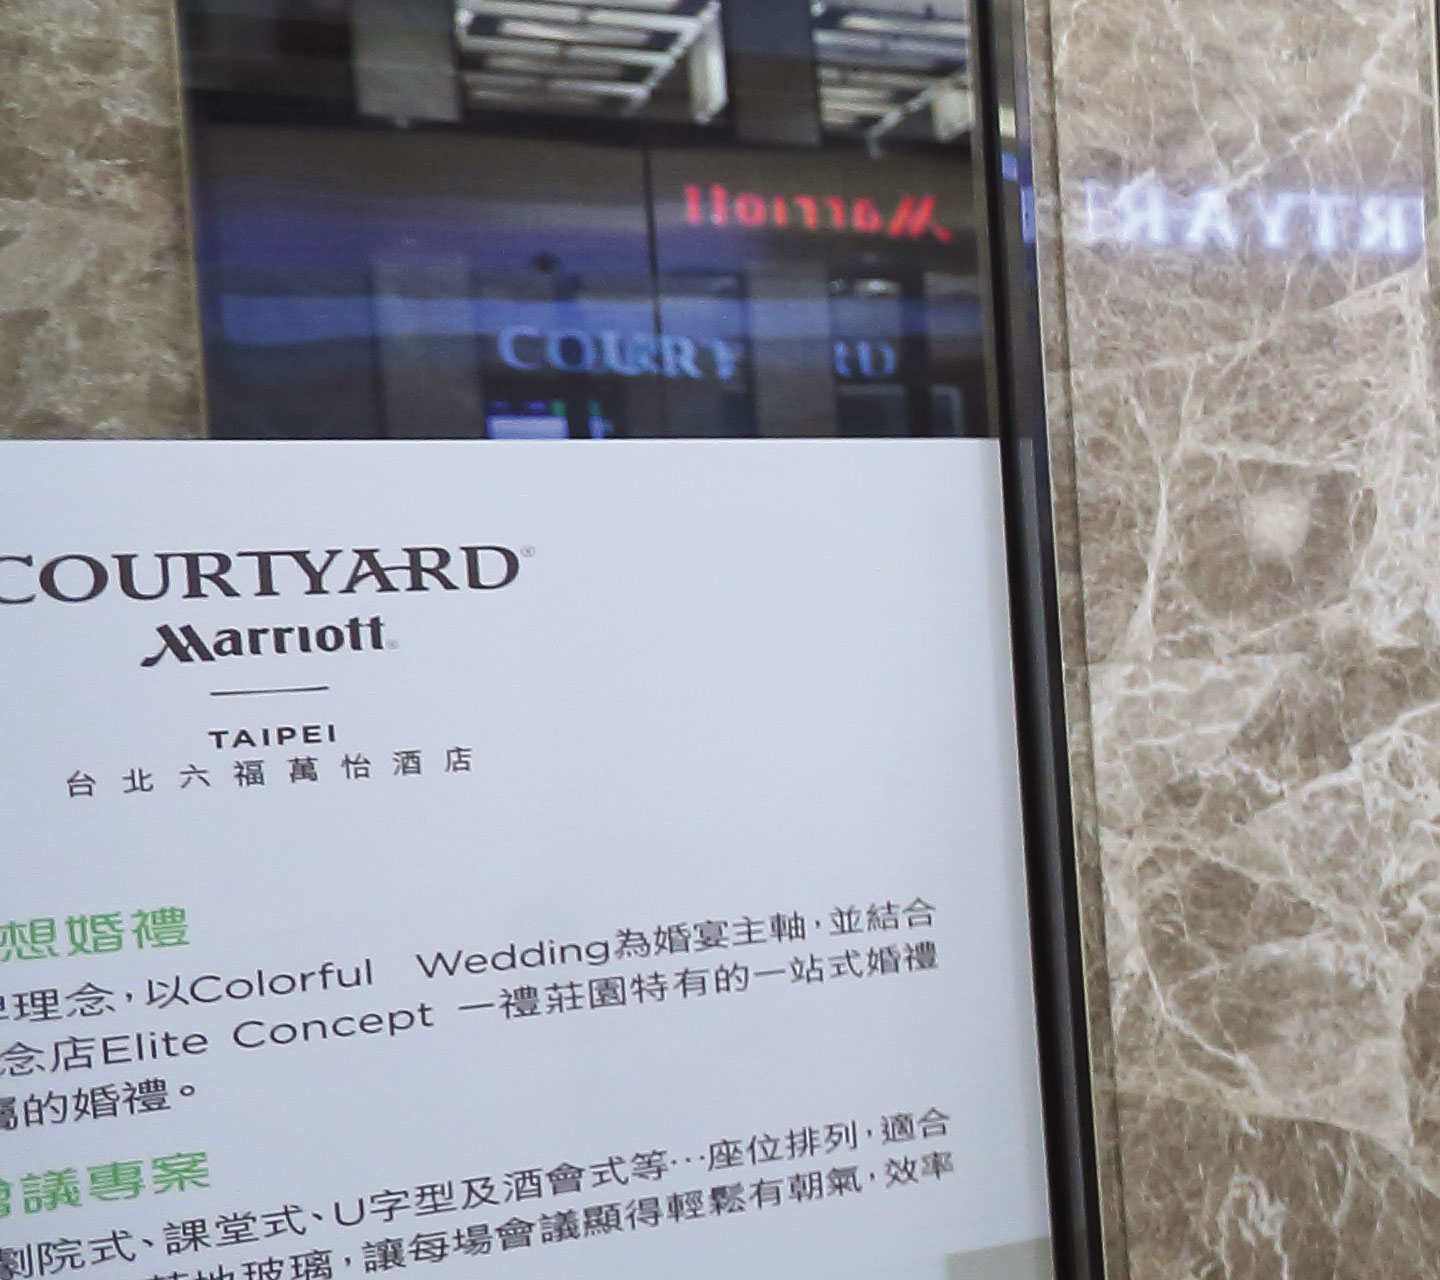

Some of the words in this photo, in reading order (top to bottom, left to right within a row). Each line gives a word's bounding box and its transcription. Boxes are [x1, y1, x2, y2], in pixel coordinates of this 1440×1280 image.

[140, 616, 386, 667] Marriott
[208, 724, 338, 750] TAIPEI
[65, 746, 473, 799] 台北六福萬怡酒店
[0, 905, 190, 963] 想婚禮
[232, 1002, 435, 1050] Concept
